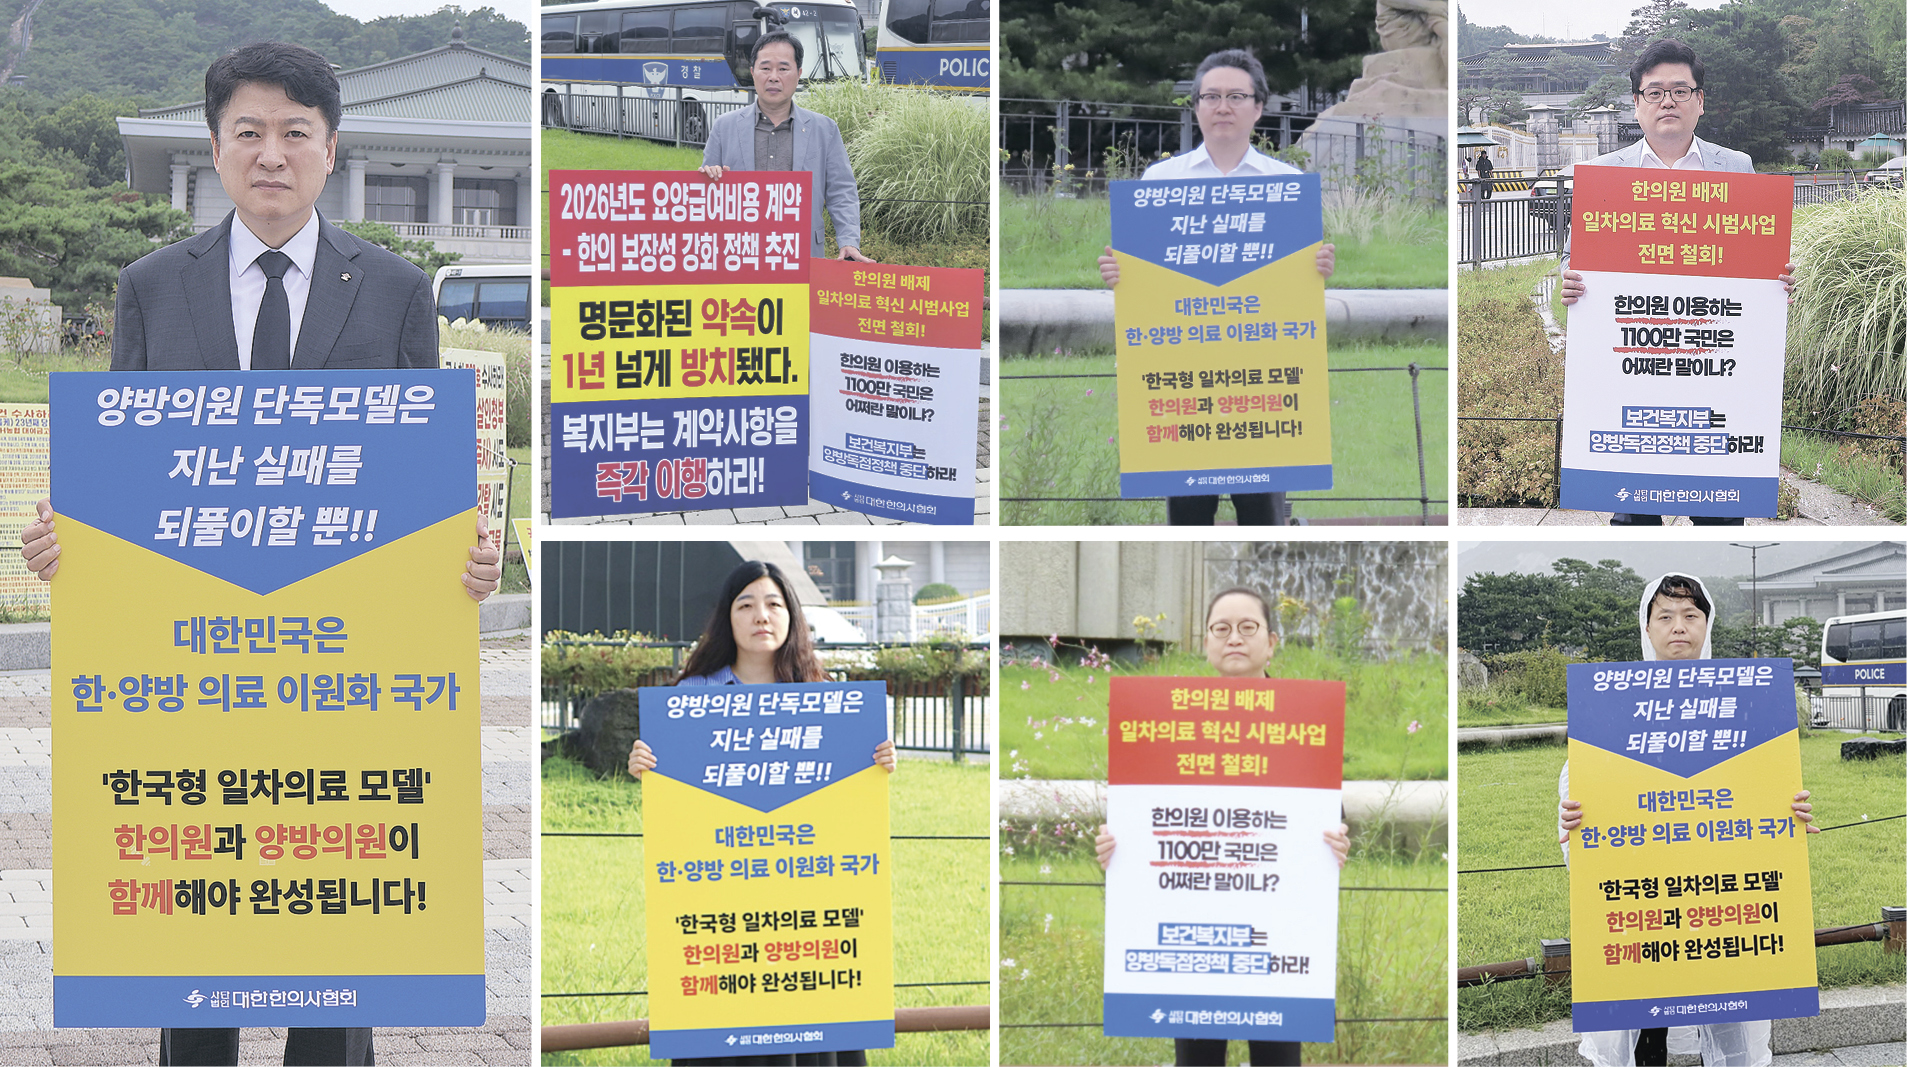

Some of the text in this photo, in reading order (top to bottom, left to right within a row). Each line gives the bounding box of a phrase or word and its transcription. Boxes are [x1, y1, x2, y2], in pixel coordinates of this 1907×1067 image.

[680, 65, 702, 80] 경찰
[939, 57, 990, 77] POLIC
[561, 181, 802, 222] 2026년도 요양급여비용 계약
[1134, 182, 1301, 208] 양방의원 단독모델은
[1632, 180, 1729, 203] 한의원 배제
[1170, 212, 1266, 235] 지난 실패를
[1582, 211, 1776, 236] 일차의료 혁신 시범사업
[577, 232, 800, 272] 한의 보장성 강화 정책 추진
[1164, 242, 1274, 264] 되풀이할 뿐!!
[1638, 243, 1724, 266] 전면 철회!
[853, 270, 930, 292] 한의원 배제
[817, 290, 970, 318] 일차의료 혁신 시범사업
[1174, 295, 1261, 316] 대한민국은
[1614, 294, 1742, 317] 한의원 이용하는
[579, 298, 782, 340] 명문화된 약속이
[858, 317, 926, 339] 전면 철회!
[1126, 320, 1317, 346] 한·양방 의료 이원화 국가
[1620, 327, 1734, 348] 1100만 국민은
[563, 346, 798, 390] 1년 넘게 방치됐다.
[840, 352, 940, 378] 한의원 이용하는
[1622, 357, 1736, 377] 어쩌란 말이냐?
[844, 376, 934, 402] 1100만 국민은
[1142, 366, 1304, 390] '한국형 일차의료 모델'
[96, 383, 436, 428] 양방의원 단독모델은
[846, 400, 934, 422] 어쩌란 말이냐?
[1148, 393, 1298, 416] 한의원과 양방의원이
[562, 405, 798, 453] 복지부는 계약사항을
[1626, 408, 1726, 428] 보건복지부는
[1146, 420, 1302, 443] 함께해야 완성됩니다!
[1590, 432, 1764, 454] 양방독점정책 중단하라!
[848, 436, 926, 460] 보건복지부는
[168, 444, 364, 487] 지난 실패를
[823, 448, 956, 482] 양방독점정책 중단하라!
[596, 456, 764, 502] 즉각 이행하라!
[1208, 474, 1270, 485] 대한한의사협회
[1650, 489, 1740, 503] 대한한의사협회
[154, 506, 379, 548] 되풀이할 뿐!!
[174, 614, 348, 654] 대한민국은
[1593, 666, 1774, 692] 양방의원 단독모델은
[1854, 668, 1886, 680] POLICE
[70, 672, 461, 714] 한·양방 의료 이원화 국가
[666, 690, 864, 718] 양방의원 단독모델은
[1170, 688, 1275, 712] 한의원 배제
[1632, 697, 1738, 722] 지난 실패를
[710, 725, 824, 752] 지난 실패를
[1119, 720, 1326, 746] 일차의료 혁신 시범사업
[1626, 730, 1748, 754] 되풀이할 뿐!!
[702, 761, 832, 787] 되풀이할 뿐!!
[1176, 753, 1268, 777] 전면 철회!
[102, 767, 432, 806] '한국형 일차의료 모델'
[1638, 788, 1734, 812] 대한민국은
[1151, 807, 1288, 830] 한의원 이용하는
[114, 822, 420, 860] 한의원과 양방의원이
[714, 824, 816, 848] 대한민국은
[1580, 816, 1796, 849] 한·양방 의료 이원화 국가
[1158, 841, 1278, 862] 1100만 국민은
[656, 853, 880, 883] 한·양방 의료 이원화 국가
[1158, 872, 1280, 892] 어쩌란 말이냐?
[1599, 870, 1782, 901] '한국형 일차의료 모델'
[108, 878, 427, 916] 함께해야 완성됩니다!
[676, 907, 864, 934] '한국형 일차의료 모델'
[1606, 902, 1778, 932] 한의원과 양방의원이
[1161, 925, 1268, 946] 보건복지부는
[682, 938, 858, 966] 한의원과 양방의원이
[1603, 934, 1784, 966] 함께해야 완성됩니다!
[1126, 951, 1310, 975] 양방독점정책 중단하라!
[680, 969, 862, 996] 함께해야 완성됩니다!
[210, 990, 230, 1000] 사단
[210, 1000, 230, 1008] 법인
[232, 989, 358, 1008] 대한한의사협회
[1185, 1010, 1283, 1026] 대한한의사협회
[1676, 1000, 1748, 1016] 대한한의사협회
[752, 1031, 824, 1046] 대한한의사협회
